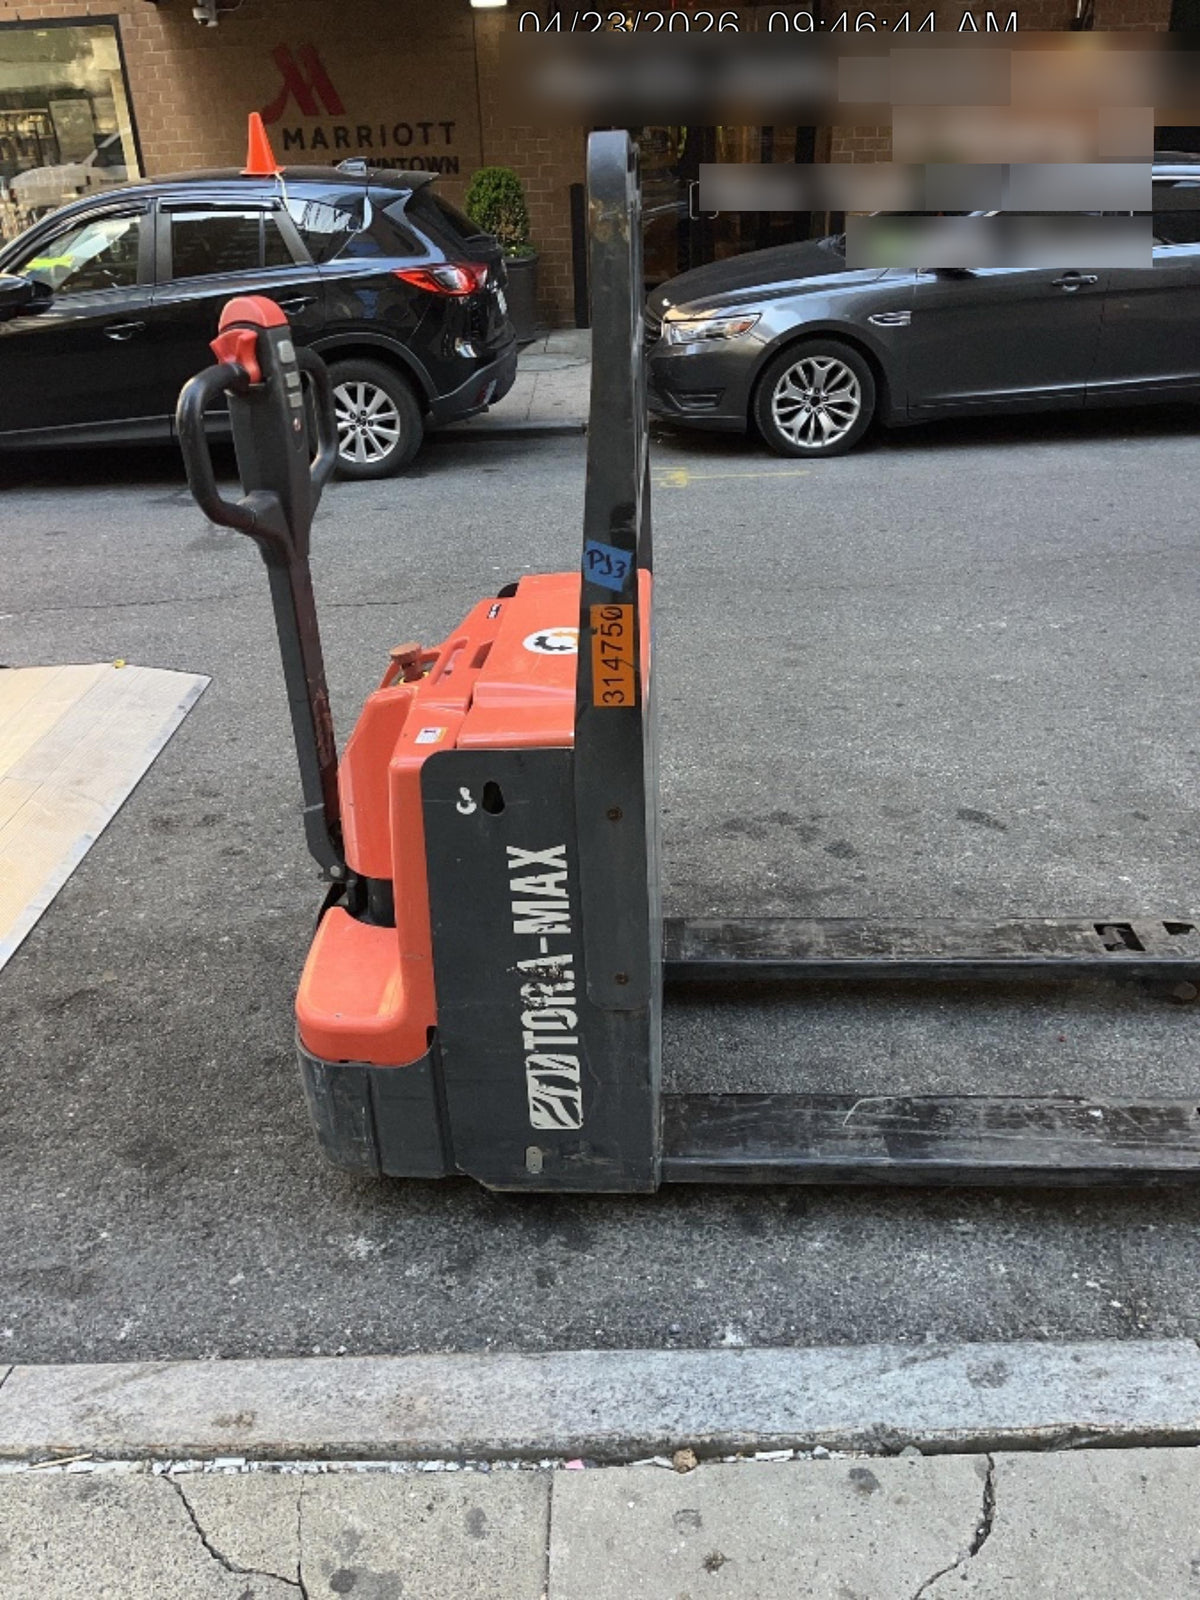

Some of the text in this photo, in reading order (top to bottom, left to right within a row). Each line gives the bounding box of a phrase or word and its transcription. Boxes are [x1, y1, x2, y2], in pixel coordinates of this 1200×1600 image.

[282, 122, 456, 151] MARRIOTT
[600, 605, 625, 704] 314750
[508, 844, 579, 1050] TORA-MAX
